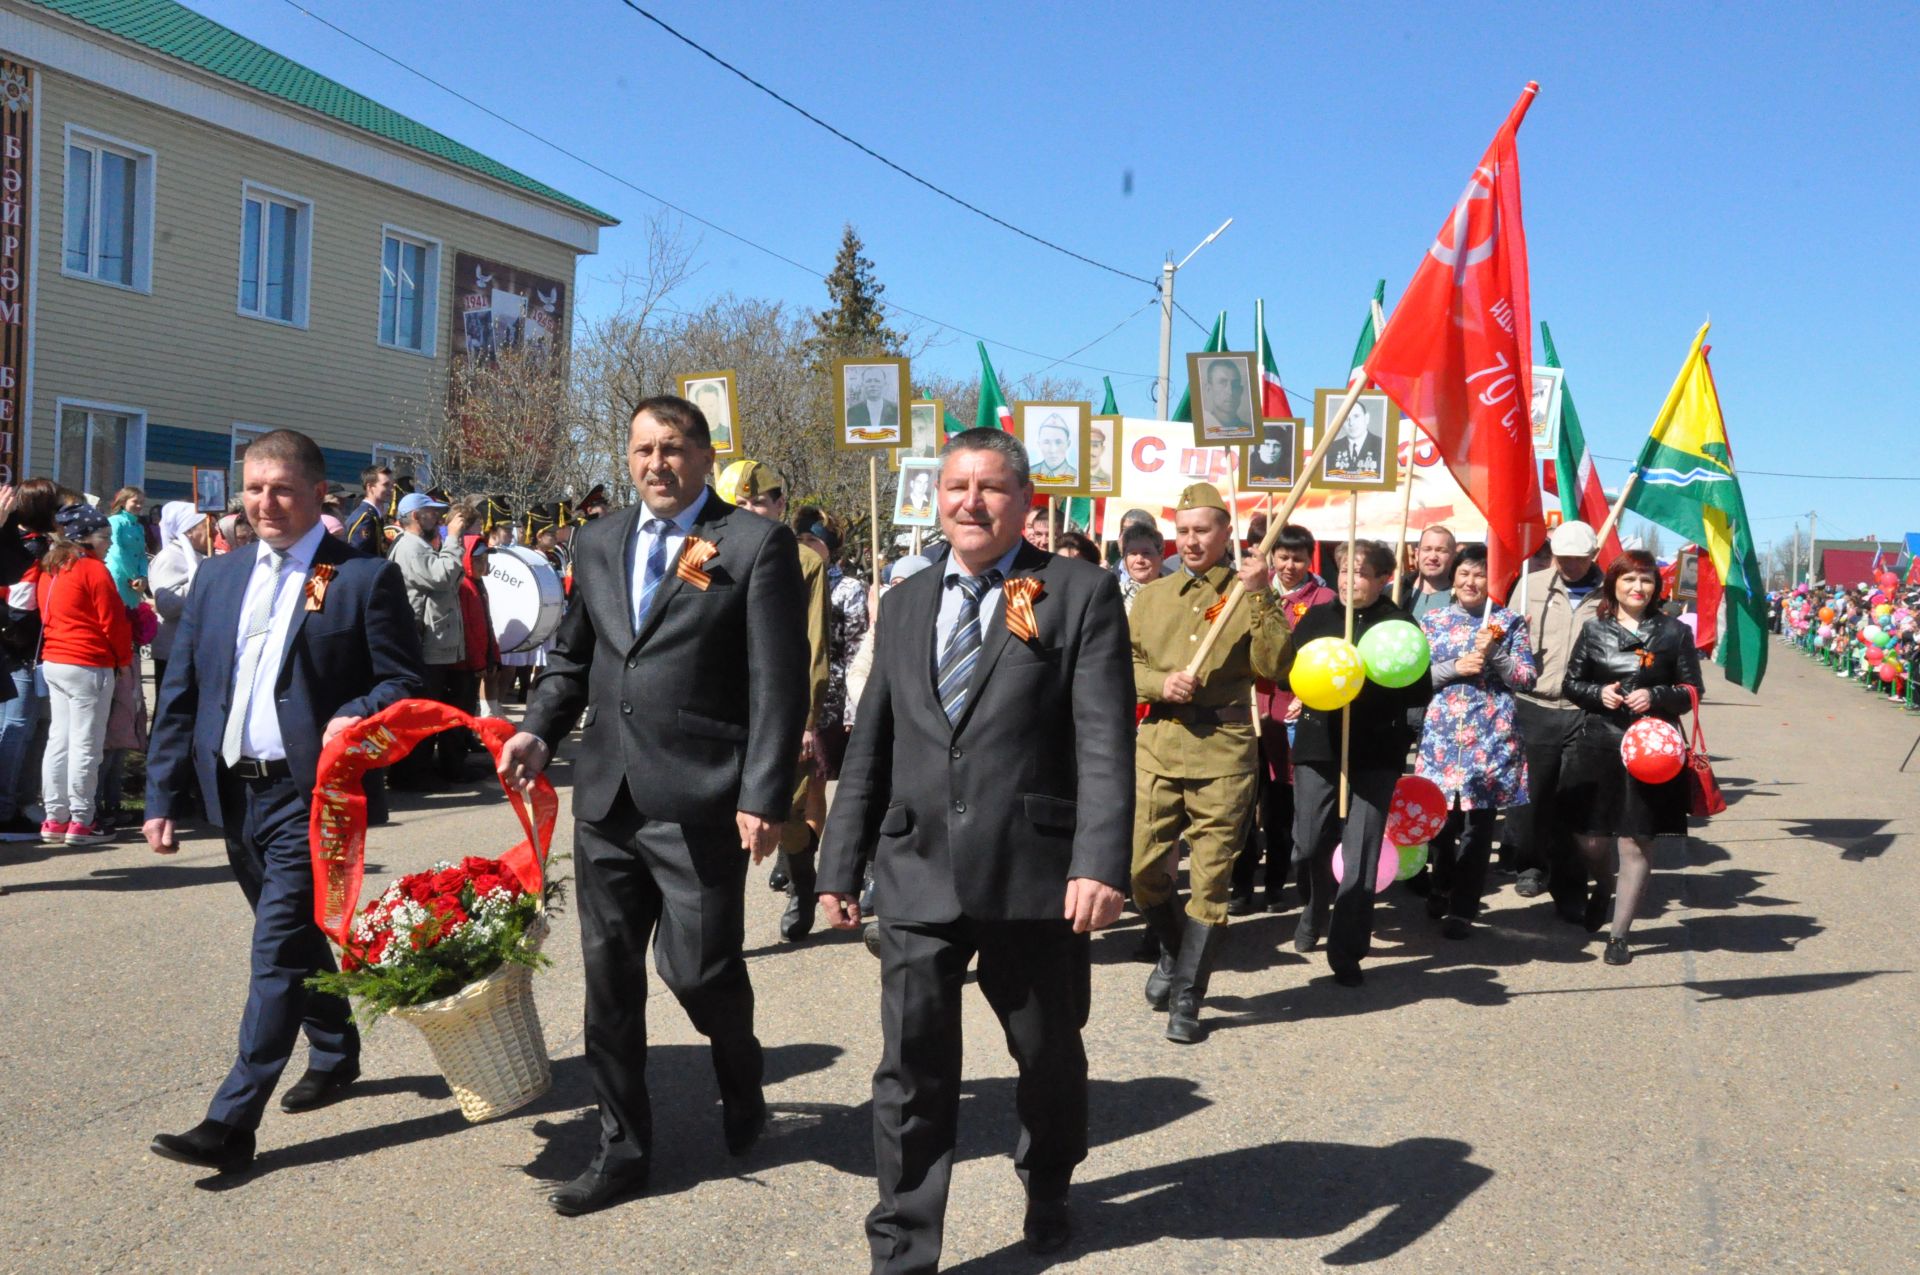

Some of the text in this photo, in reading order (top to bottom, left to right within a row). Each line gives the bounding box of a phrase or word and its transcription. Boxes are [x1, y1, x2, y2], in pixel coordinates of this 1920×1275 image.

[463, 294, 488, 309] 1941
[531, 309, 554, 332] 1945
[1464, 351, 1517, 406] 79
[1131, 435, 1167, 473] С
